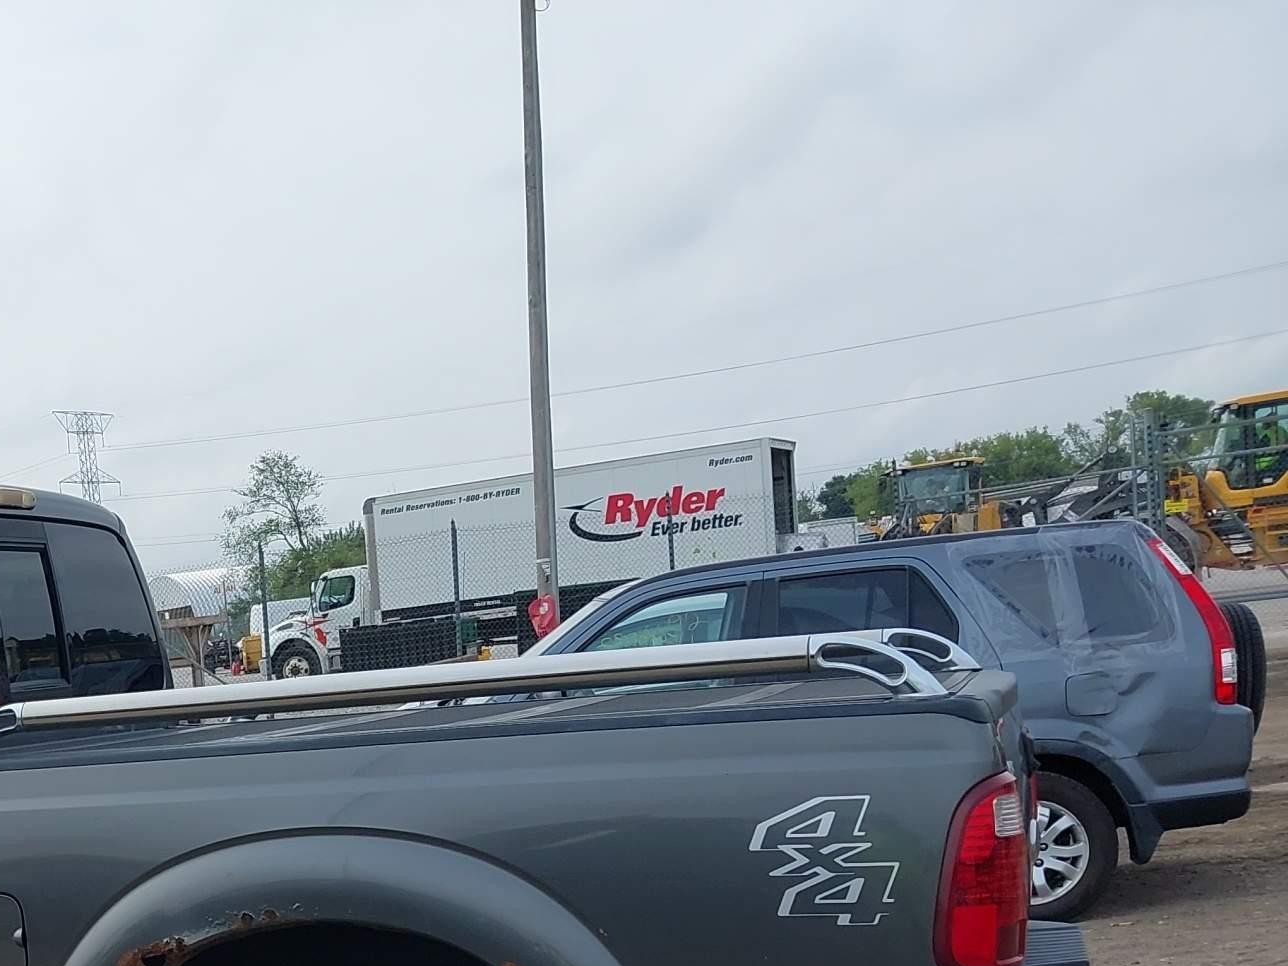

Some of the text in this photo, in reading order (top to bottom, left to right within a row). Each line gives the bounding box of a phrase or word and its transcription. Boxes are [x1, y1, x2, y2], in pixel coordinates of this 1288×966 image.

[708, 454, 753, 467] Ryder.com
[380, 487, 521, 515] Rental Reservations: 1-800-BY-RYDER
[604, 485, 726, 528] Ryder
[650, 513, 743, 537] Ever better.
